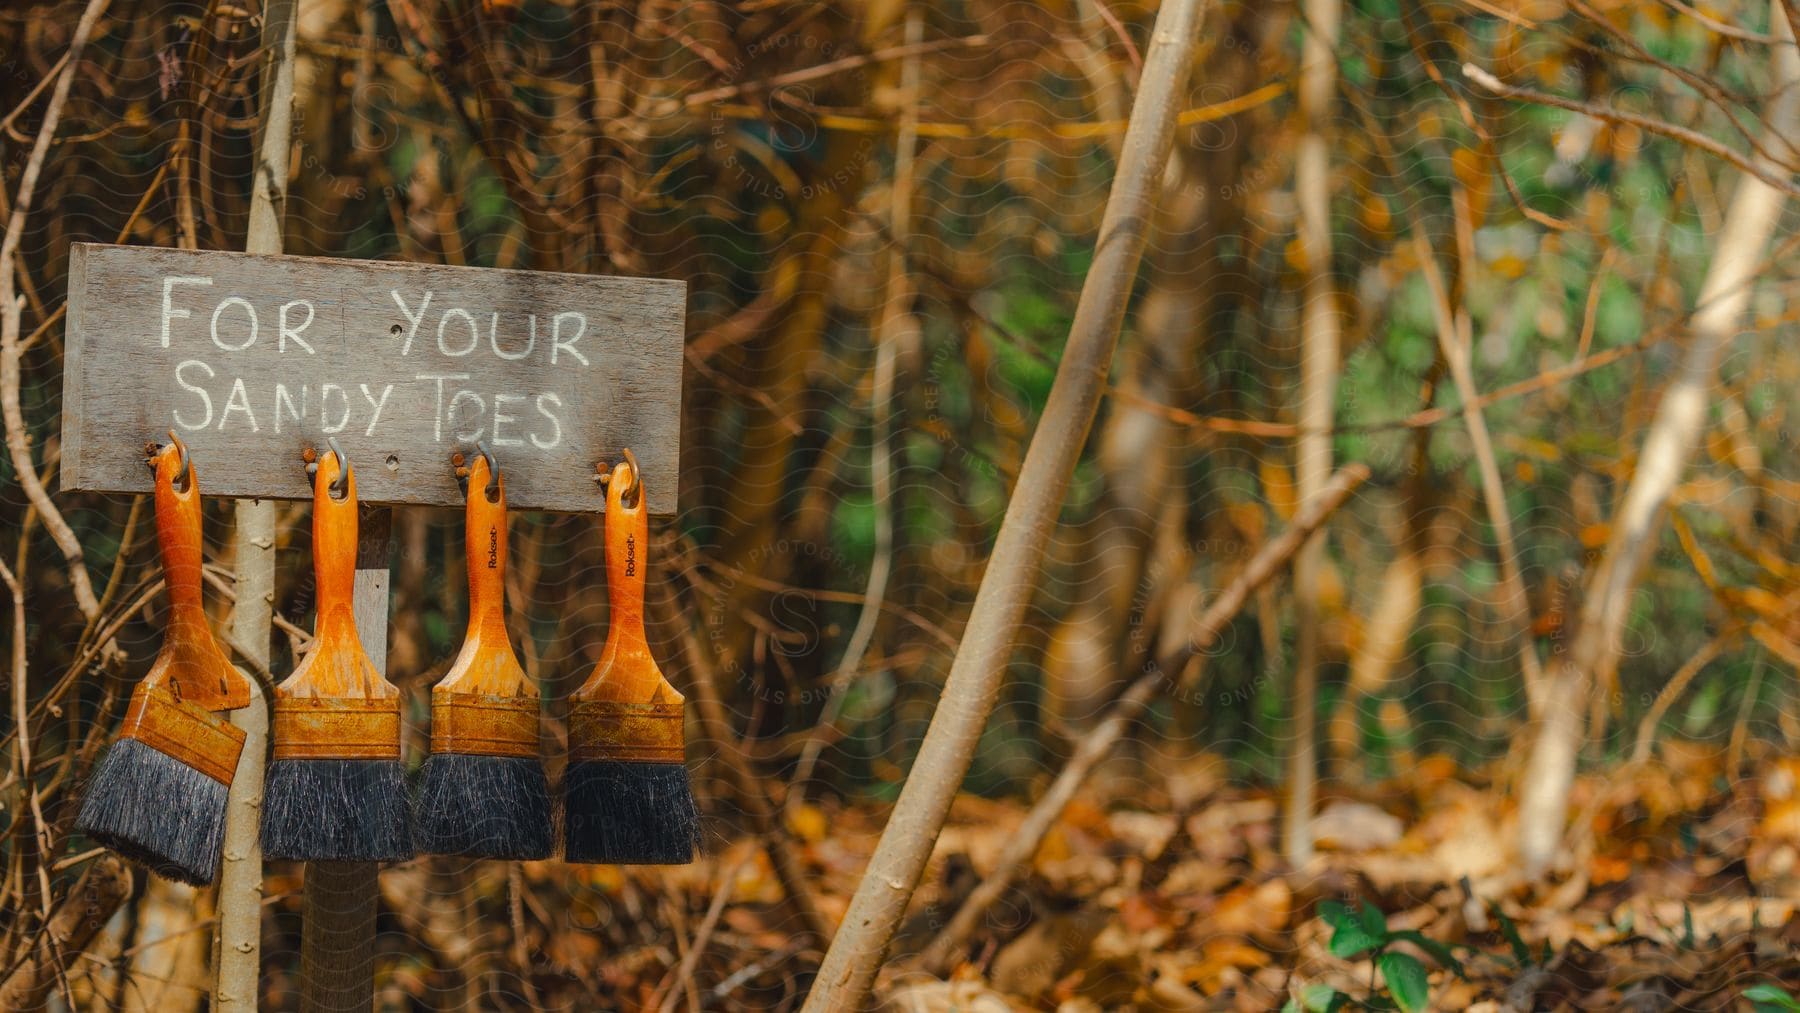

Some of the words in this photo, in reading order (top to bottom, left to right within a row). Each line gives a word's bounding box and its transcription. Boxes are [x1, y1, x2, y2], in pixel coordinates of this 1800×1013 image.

[161, 276, 315, 355] FOR
[390, 289, 589, 366] YOUR
[172, 360, 394, 437] SANDY
[416, 373, 562, 450] TOES
[488, 527, 498, 569] Rokset
[625, 537, 635, 577] Rokset
